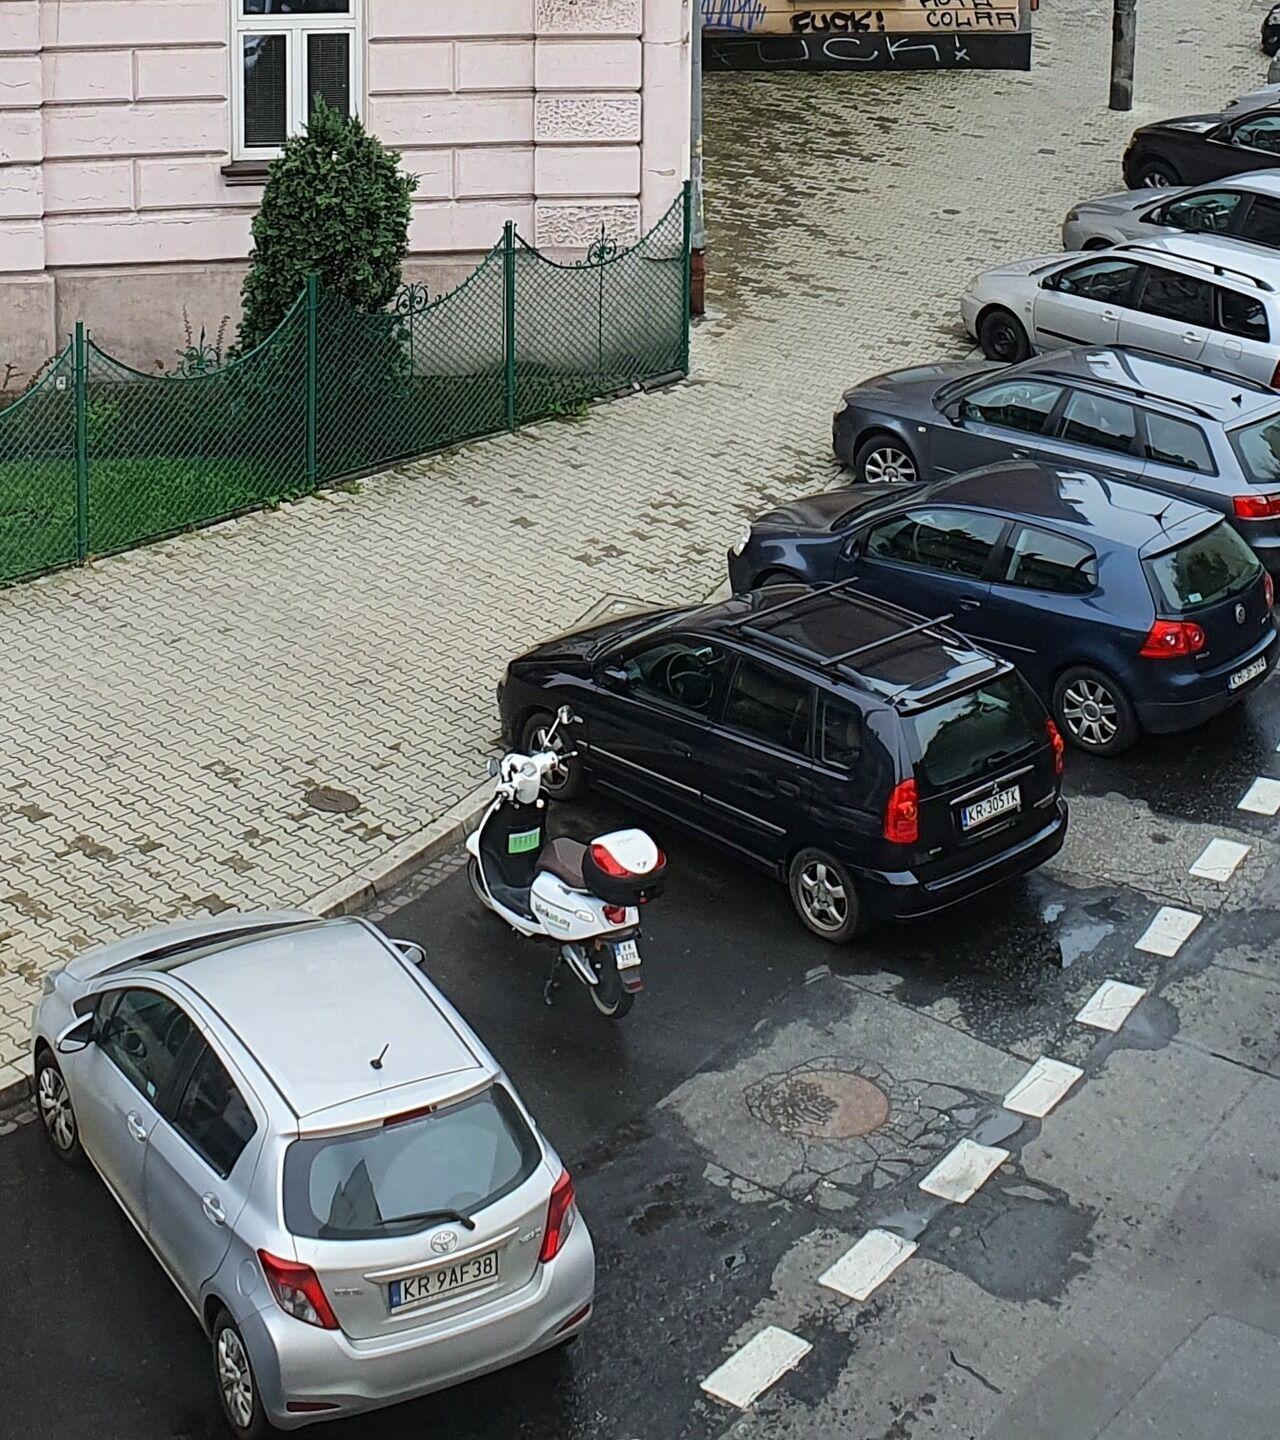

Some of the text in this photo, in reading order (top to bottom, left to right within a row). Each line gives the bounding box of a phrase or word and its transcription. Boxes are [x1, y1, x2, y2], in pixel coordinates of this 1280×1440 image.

[968, 803, 984, 822] KR
[403, 1256, 493, 1301] KR 9AF38
